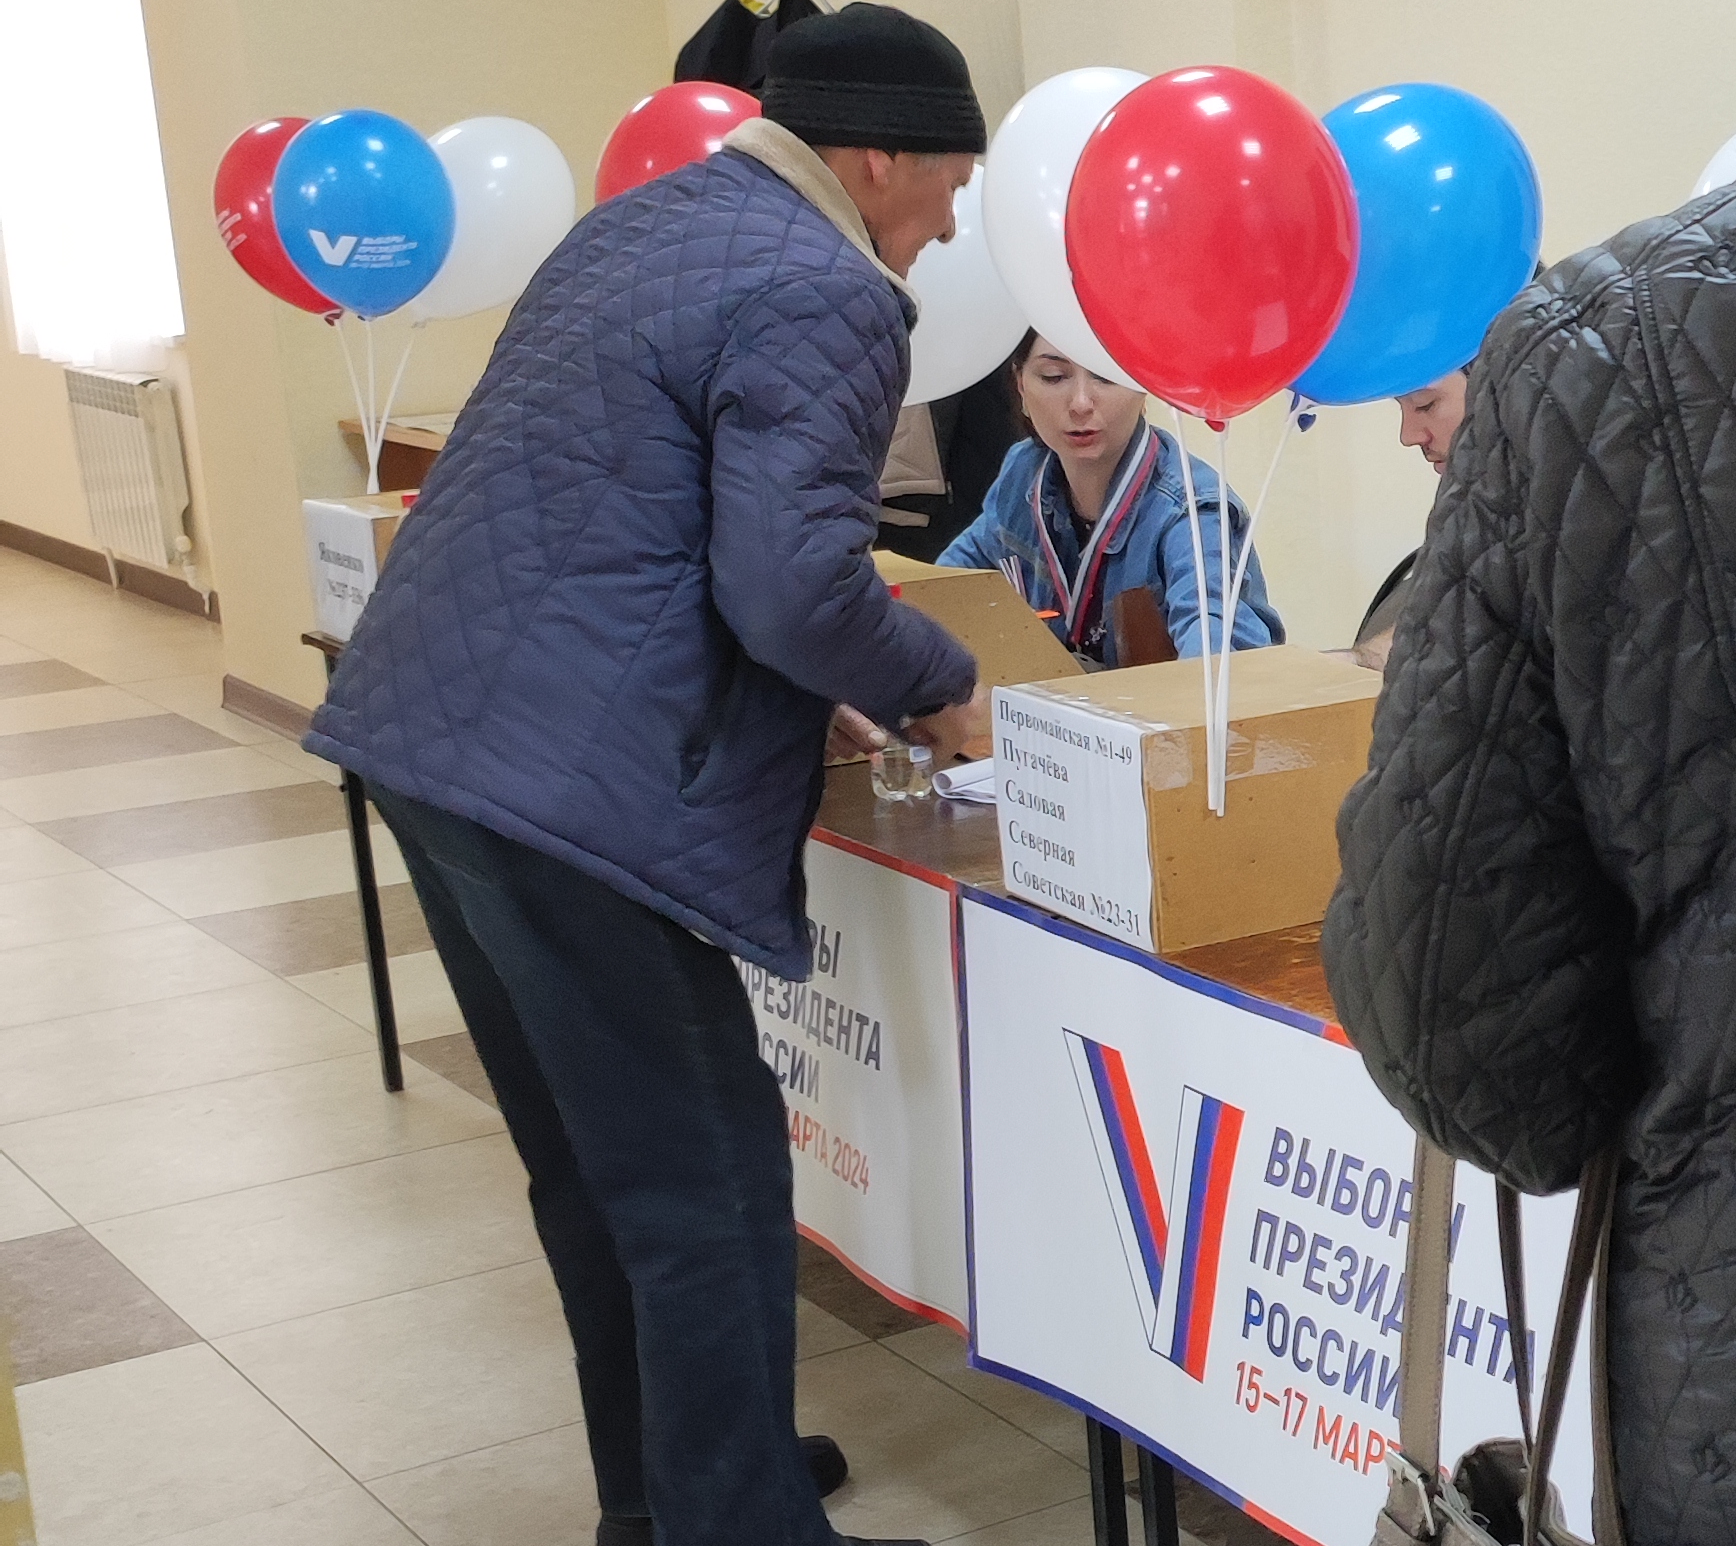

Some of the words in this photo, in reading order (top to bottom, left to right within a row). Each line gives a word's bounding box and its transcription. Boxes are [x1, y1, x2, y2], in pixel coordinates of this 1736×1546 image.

[999, 699, 1091, 751] Первомайская
[1002, 737, 1069, 783] Пугачёва
[1005, 779, 1066, 822] Садовая
[1009, 820, 1076, 867] Северная
[1012, 860, 1086, 912] Советская
[1090, 892, 1140, 937] №23-31
[786, 1105, 829, 1168] АРТА
[831, 1135, 870, 1196] 2024
[1312, 1405, 1404, 1477] МАР
